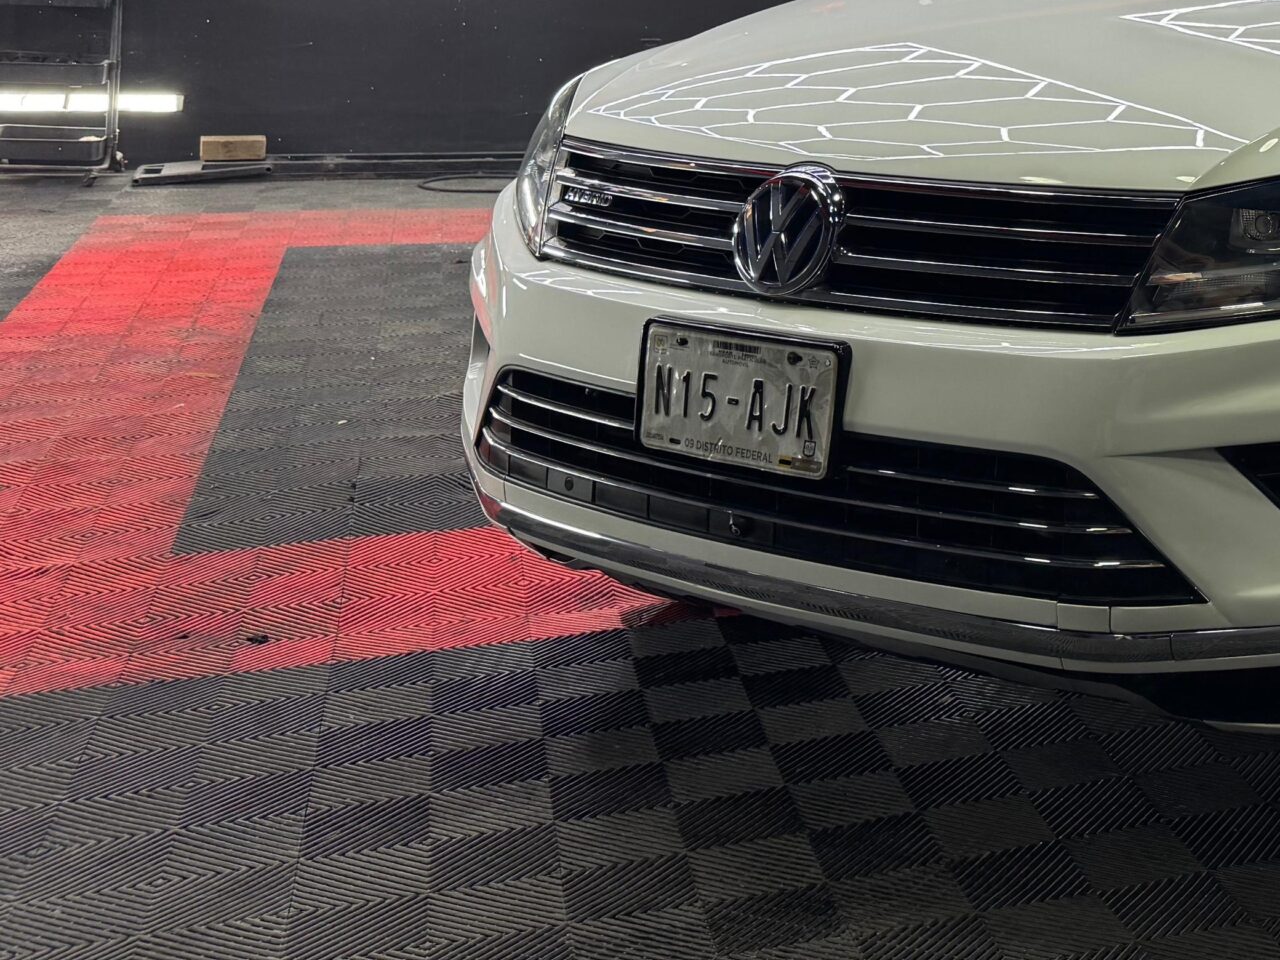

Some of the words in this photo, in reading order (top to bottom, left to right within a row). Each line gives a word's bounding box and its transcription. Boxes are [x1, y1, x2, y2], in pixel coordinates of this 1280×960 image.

[564, 187, 613, 207] HYBRID
[654, 363, 817, 440] N15-AJK
[684, 437, 695, 449] 09
[696, 440, 734, 456] DISTRITO
[735, 446, 773, 464] FEDERAL
